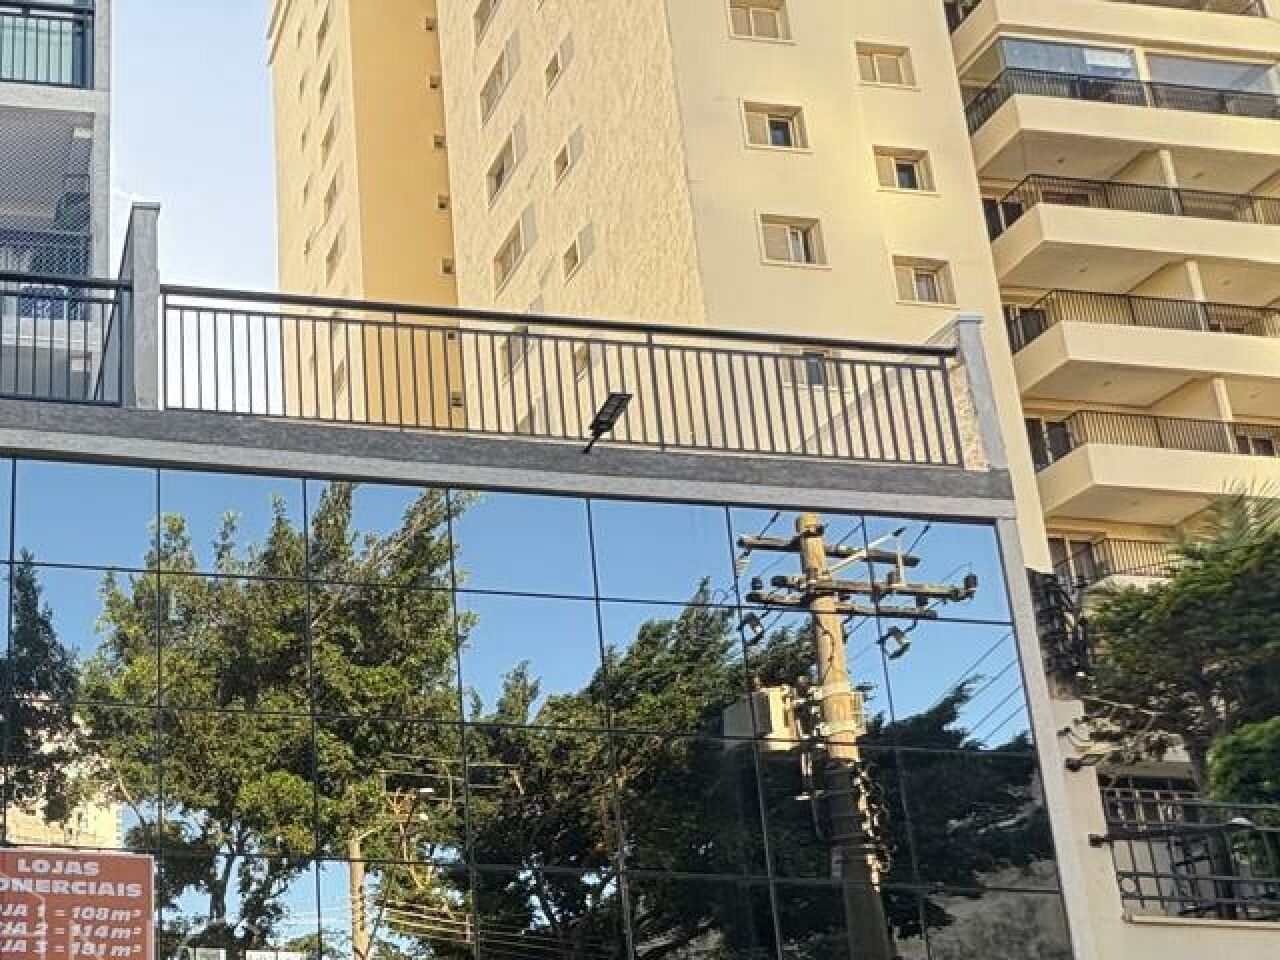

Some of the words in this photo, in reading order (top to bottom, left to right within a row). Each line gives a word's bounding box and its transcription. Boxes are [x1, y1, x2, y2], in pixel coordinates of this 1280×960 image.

[18, 858, 100, 876] LOJAS
[37, 904, 46, 917] 1
[34, 922, 48, 935] 2
